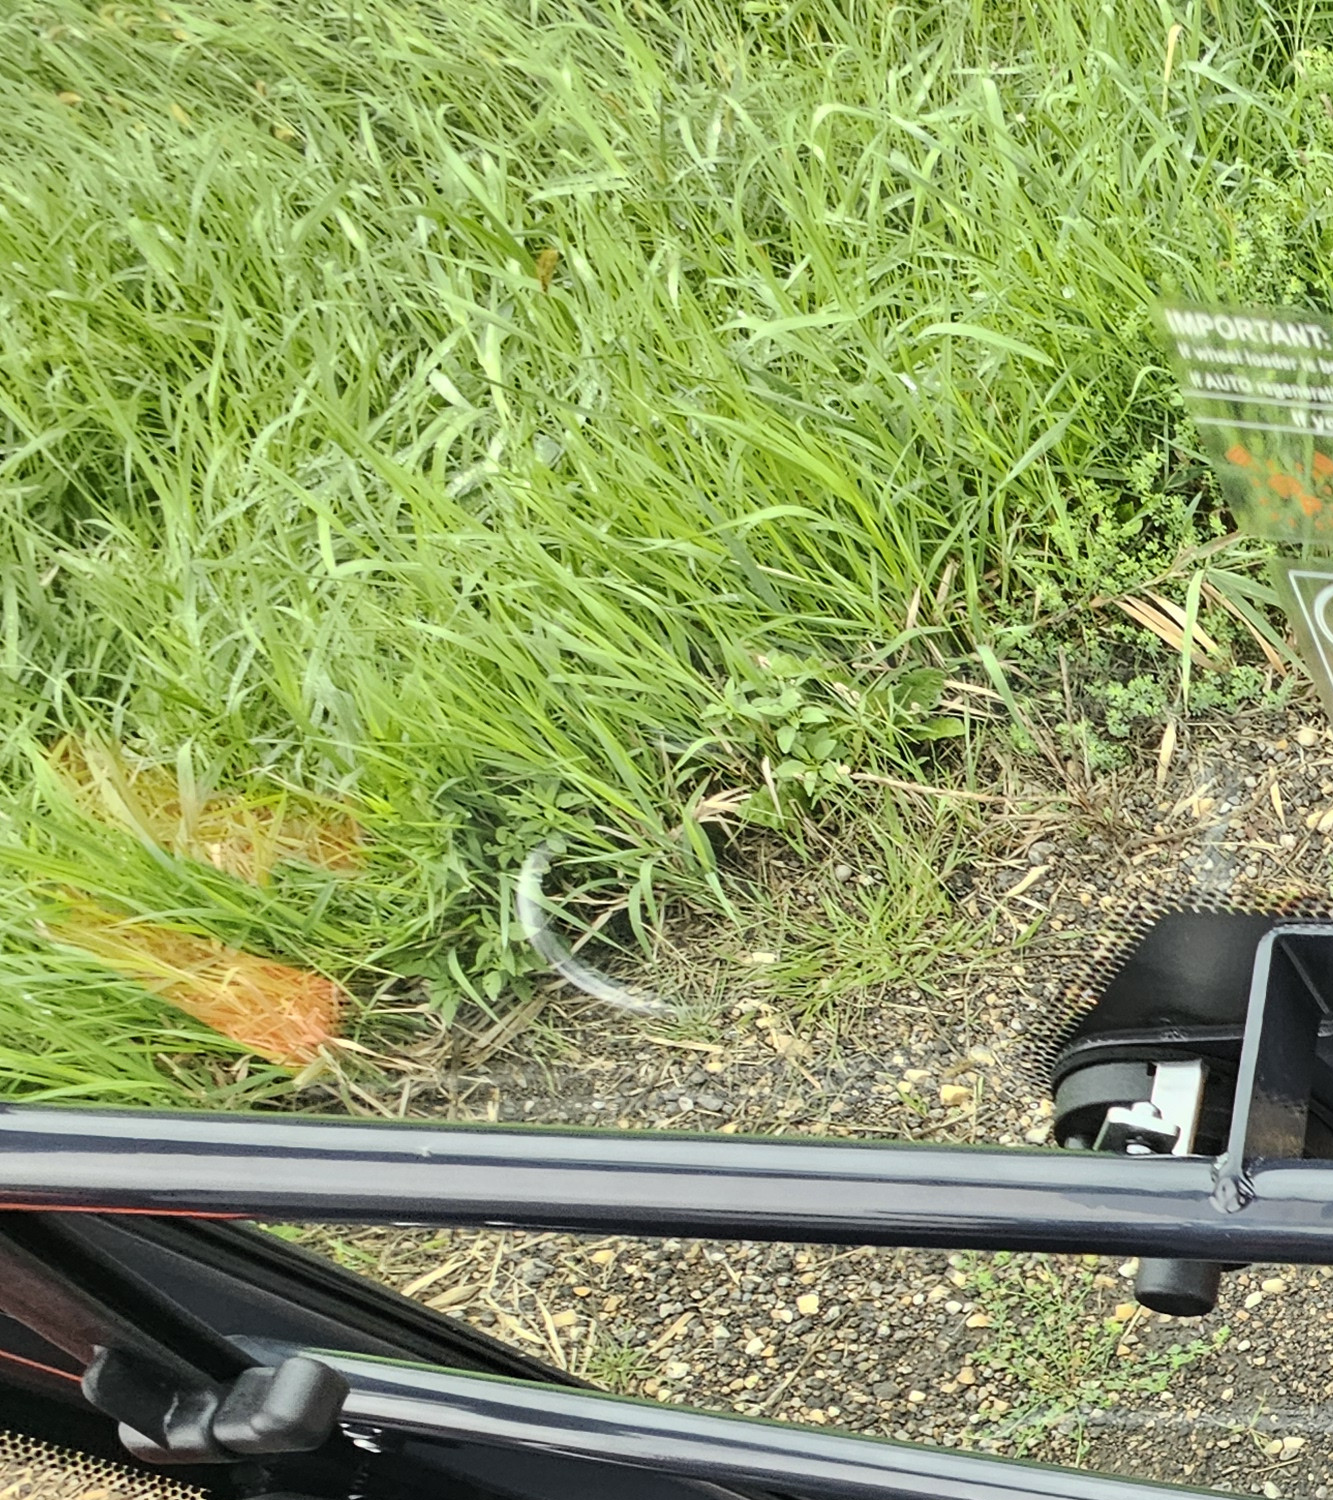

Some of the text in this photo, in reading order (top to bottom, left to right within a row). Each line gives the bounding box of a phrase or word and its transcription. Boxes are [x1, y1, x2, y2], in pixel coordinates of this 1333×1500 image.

[1162, 308, 1332, 350] IMPORTANT:
[1176, 342, 1193, 358] If
[1190, 344, 1244, 364] wheel
[1243, 350, 1298, 370] loader
[1188, 371, 1204, 387] If
[1201, 372, 1254, 392] AUTO
[1290, 410, 1309, 427] If
